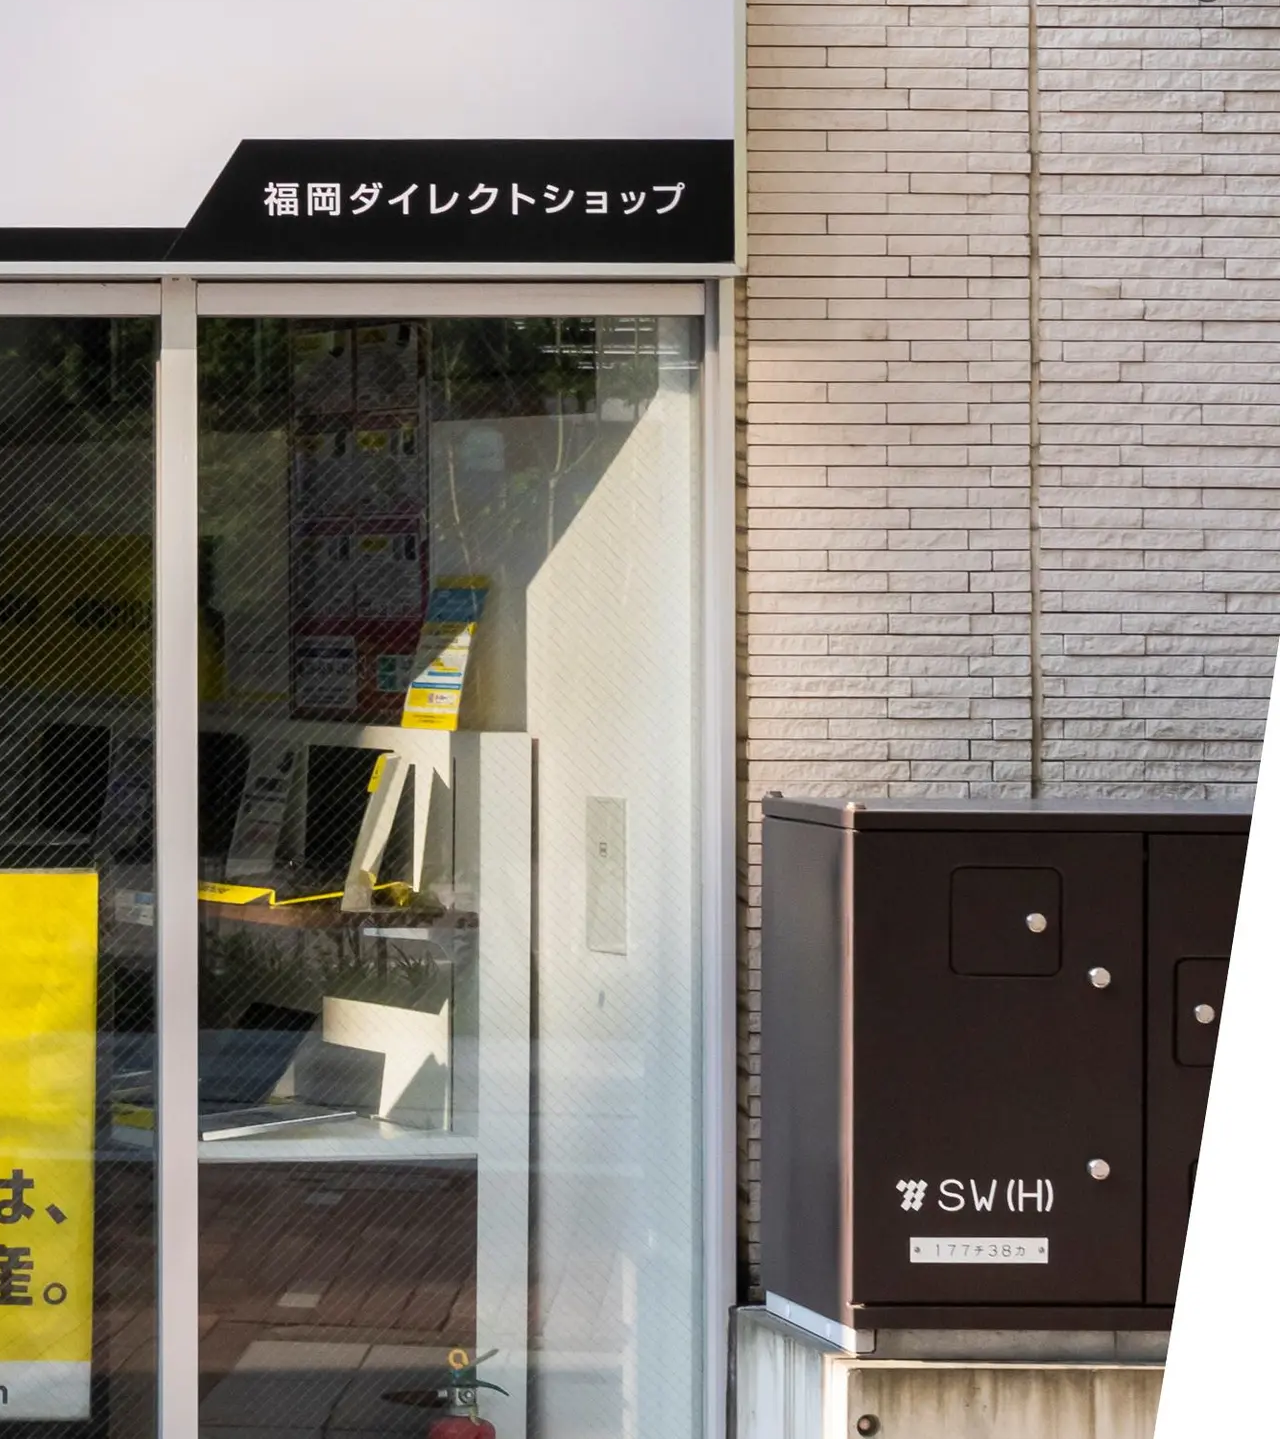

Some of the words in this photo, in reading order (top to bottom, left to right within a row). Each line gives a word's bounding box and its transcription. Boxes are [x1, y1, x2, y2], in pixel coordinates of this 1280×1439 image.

[263, 181, 686, 217] 福岡ダイレクトショップ
